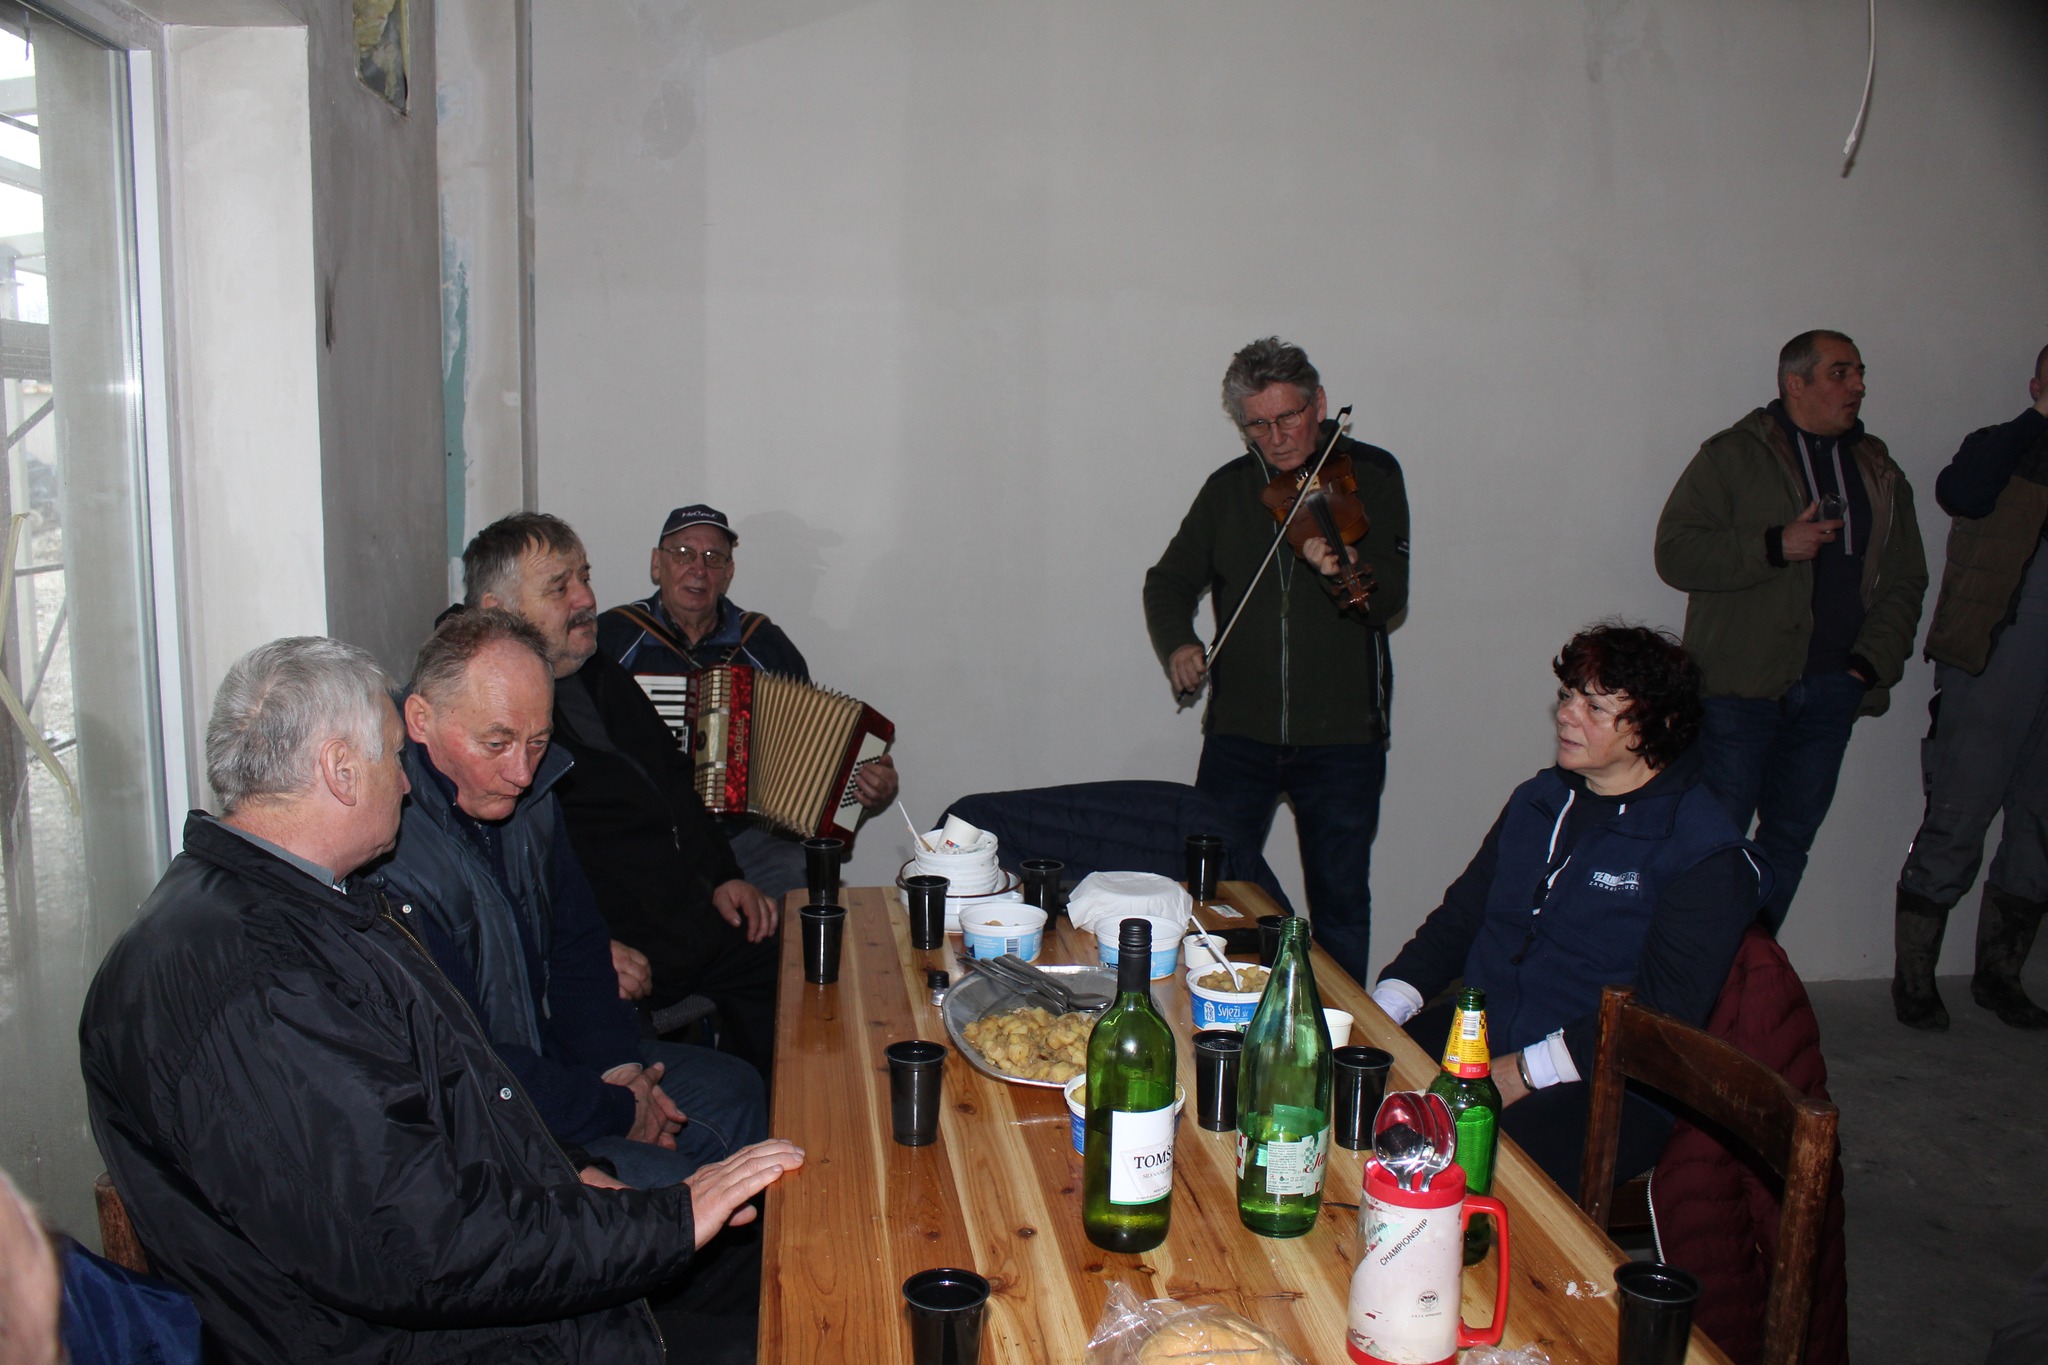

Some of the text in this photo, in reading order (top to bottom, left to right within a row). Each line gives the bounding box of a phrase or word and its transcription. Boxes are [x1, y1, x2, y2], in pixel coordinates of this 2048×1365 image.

[734, 719, 743, 761] HORCH
[1217, 1003, 1240, 1020] Svježi
[1379, 1218, 1428, 1266] CHAMPIONSHIP
